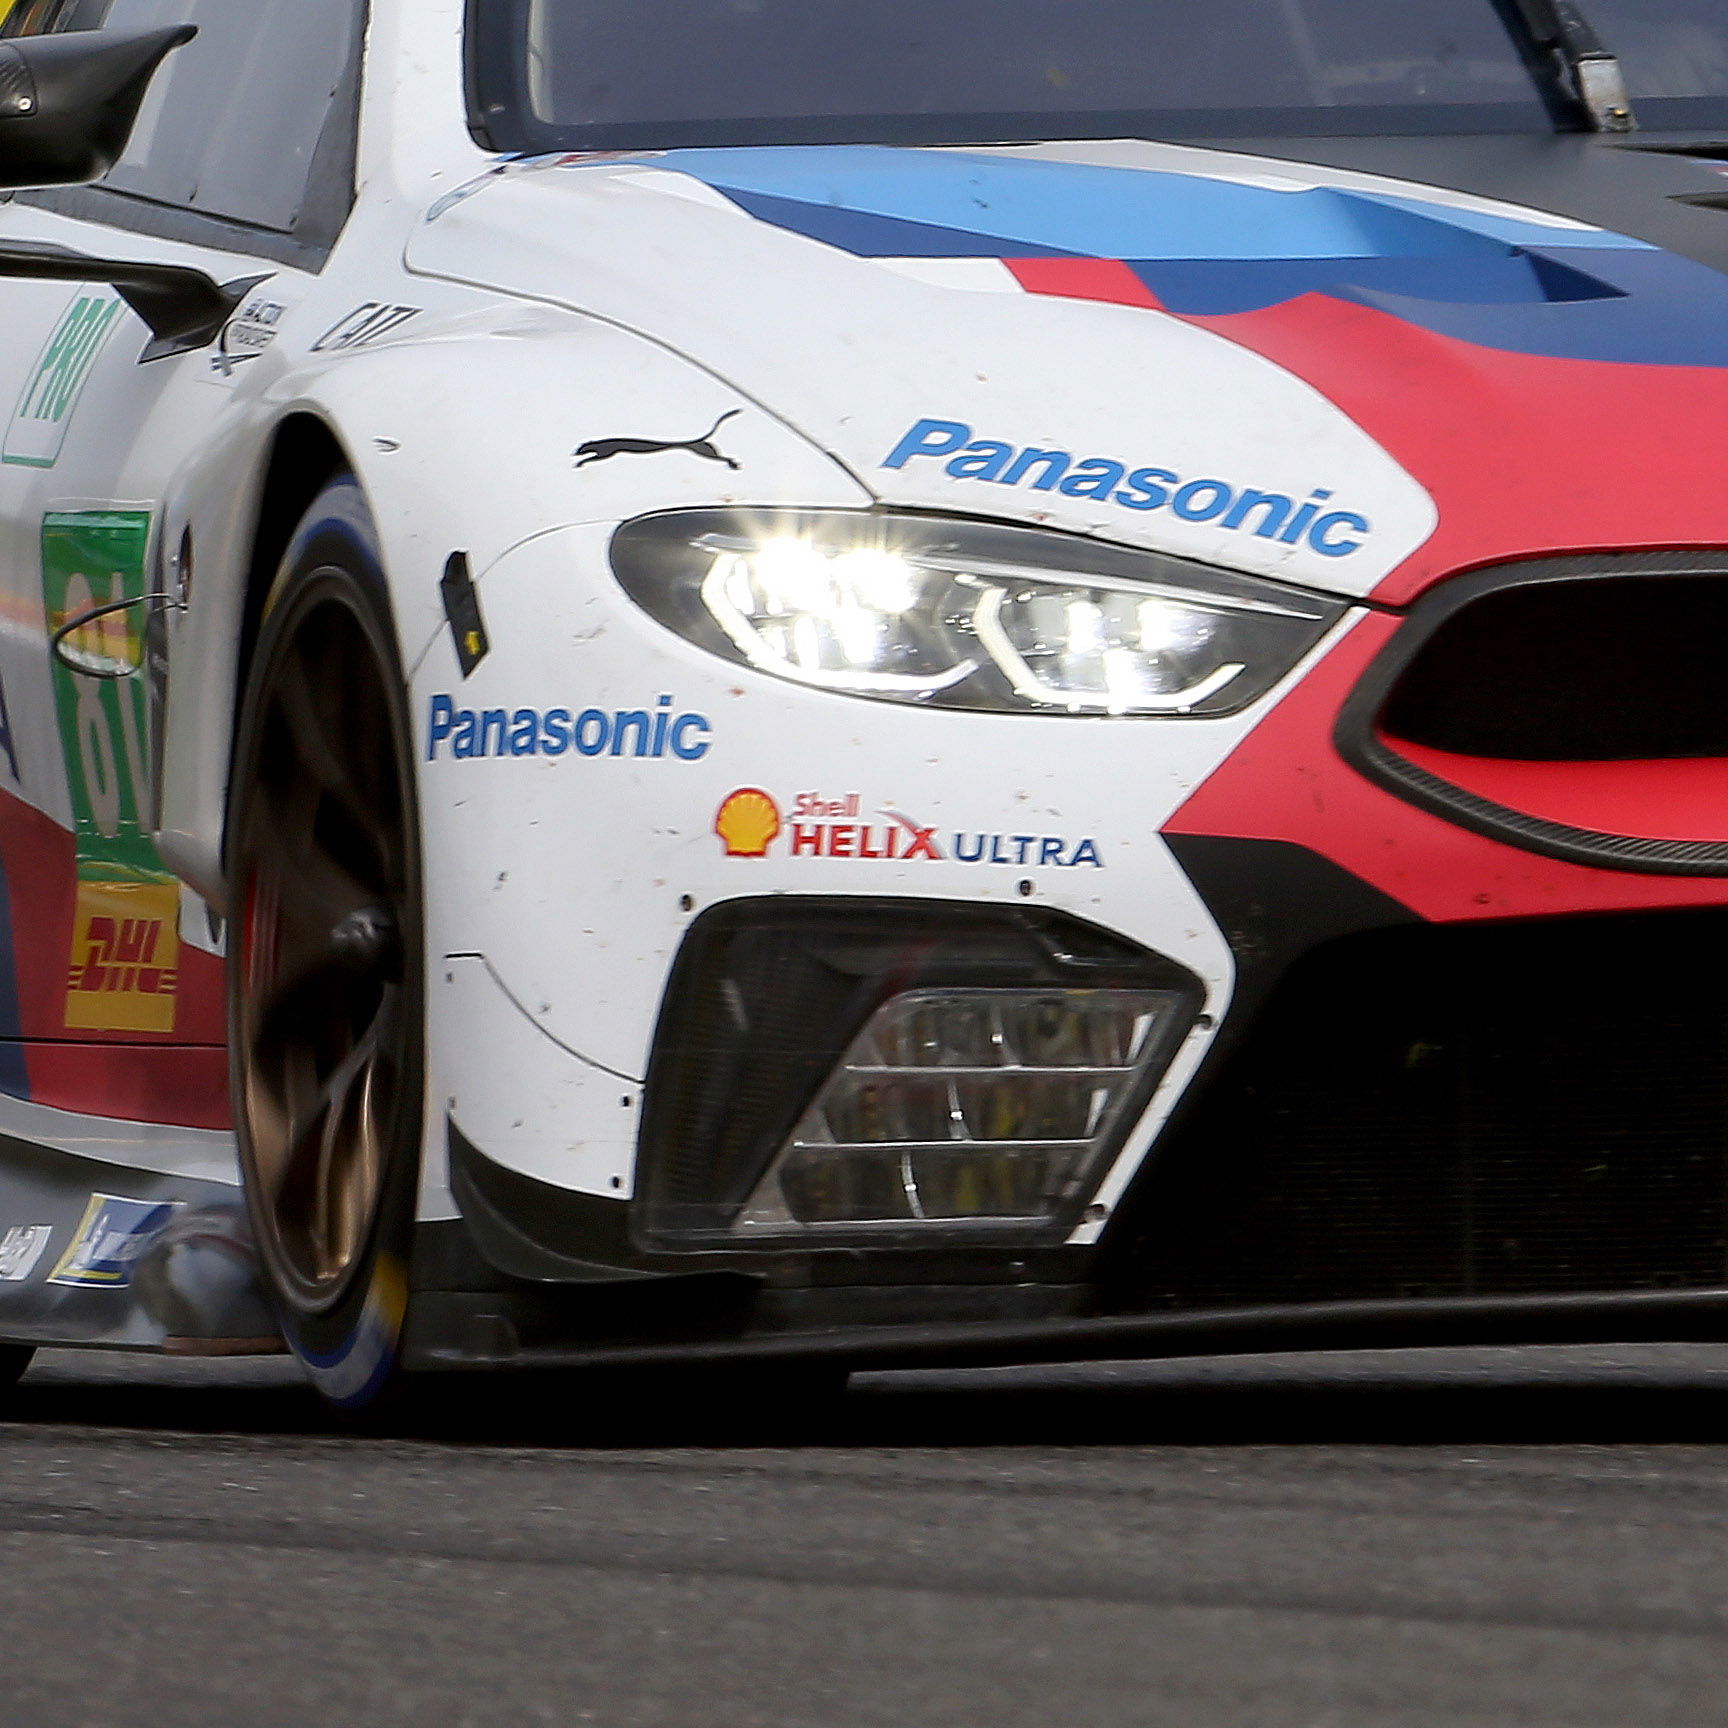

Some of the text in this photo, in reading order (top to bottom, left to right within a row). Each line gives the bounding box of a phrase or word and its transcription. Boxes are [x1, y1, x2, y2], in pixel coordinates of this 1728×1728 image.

[19, 297, 123, 423] PRO
[880, 417, 1369, 558] Panasonic
[427, 694, 713, 761] Panasonic
[793, 791, 862, 818] Shell
[791, 820, 1106, 869] HELIX ULTRA
